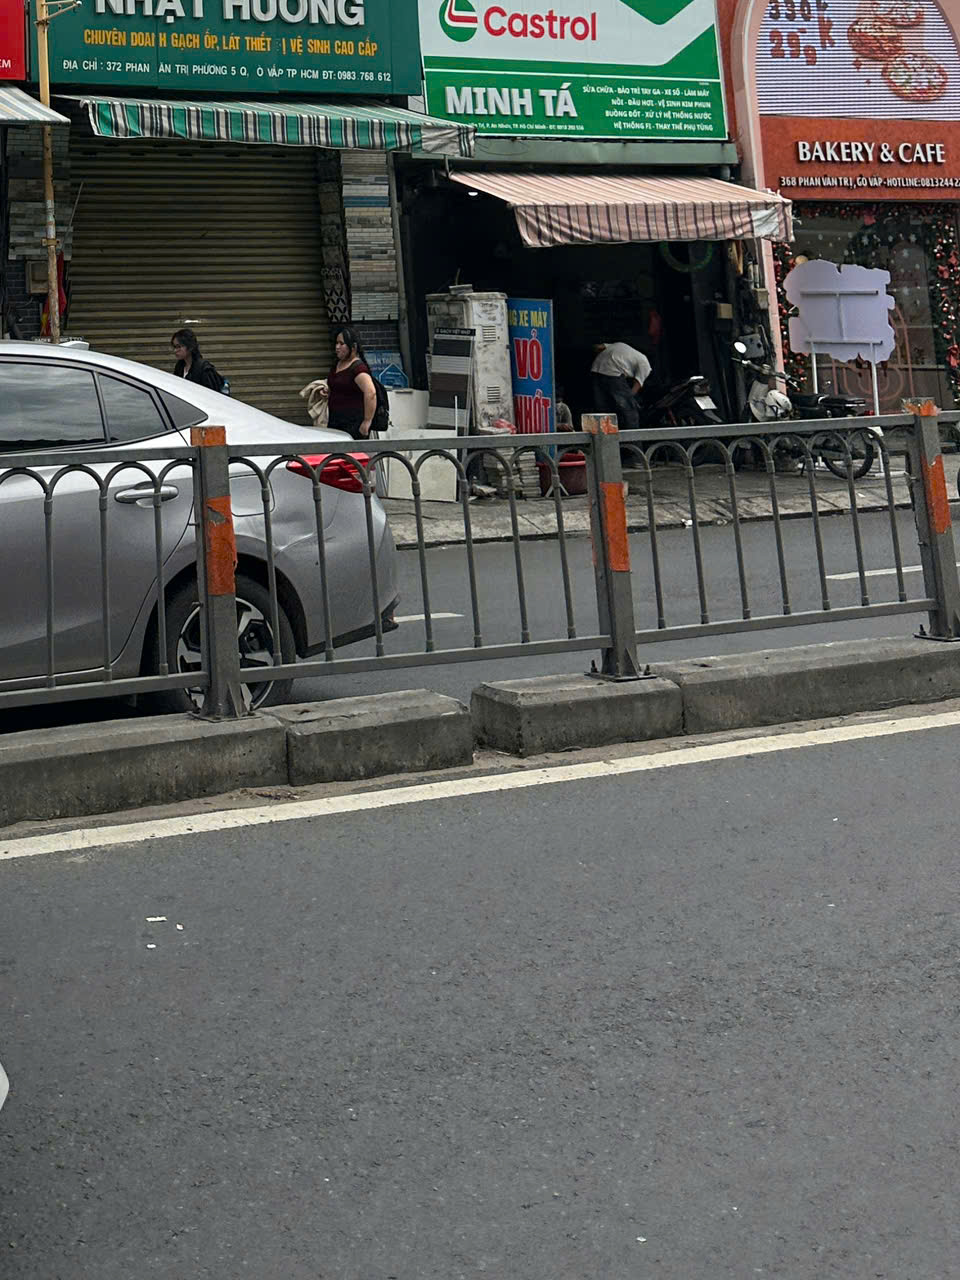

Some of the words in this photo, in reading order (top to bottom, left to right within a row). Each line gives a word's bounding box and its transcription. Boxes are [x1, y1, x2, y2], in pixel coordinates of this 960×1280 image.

[483, 5, 597, 41] Castrol
[83, 27, 127, 46] CHUYÊN
[171, 33, 200, 51] GẠCH
[222, 32, 240, 50] LÁT
[243, 31, 272, 51] THIẾT
[289, 35, 303, 56] VỆ
[307, 38, 331, 54] SINH
[335, 40, 355, 55] CAO
[358, 33, 378, 56] CẤP
[63, 59, 79, 72] ĐỊA
[106, 61, 122, 72] 372
[125, 62, 150, 73] PHAN
[175, 64, 189, 76] TRỊ
[231, 66, 236, 76] 5
[286, 69, 298, 78] TP
[300, 69, 319, 79] HCM
[445, 86, 533, 116] MINH
[539, 82, 578, 117] TÁ
[798, 141, 875, 162] BAKERY
[880, 142, 895, 162] &
[898, 142, 946, 163] CAFE
[781, 177, 797, 187] 368
[799, 177, 820, 187] PHAN
[519, 311, 529, 327] XE
[530, 308, 548, 328] MÁY
[513, 328, 543, 381] VỎ
[514, 389, 551, 433] NHỚT
